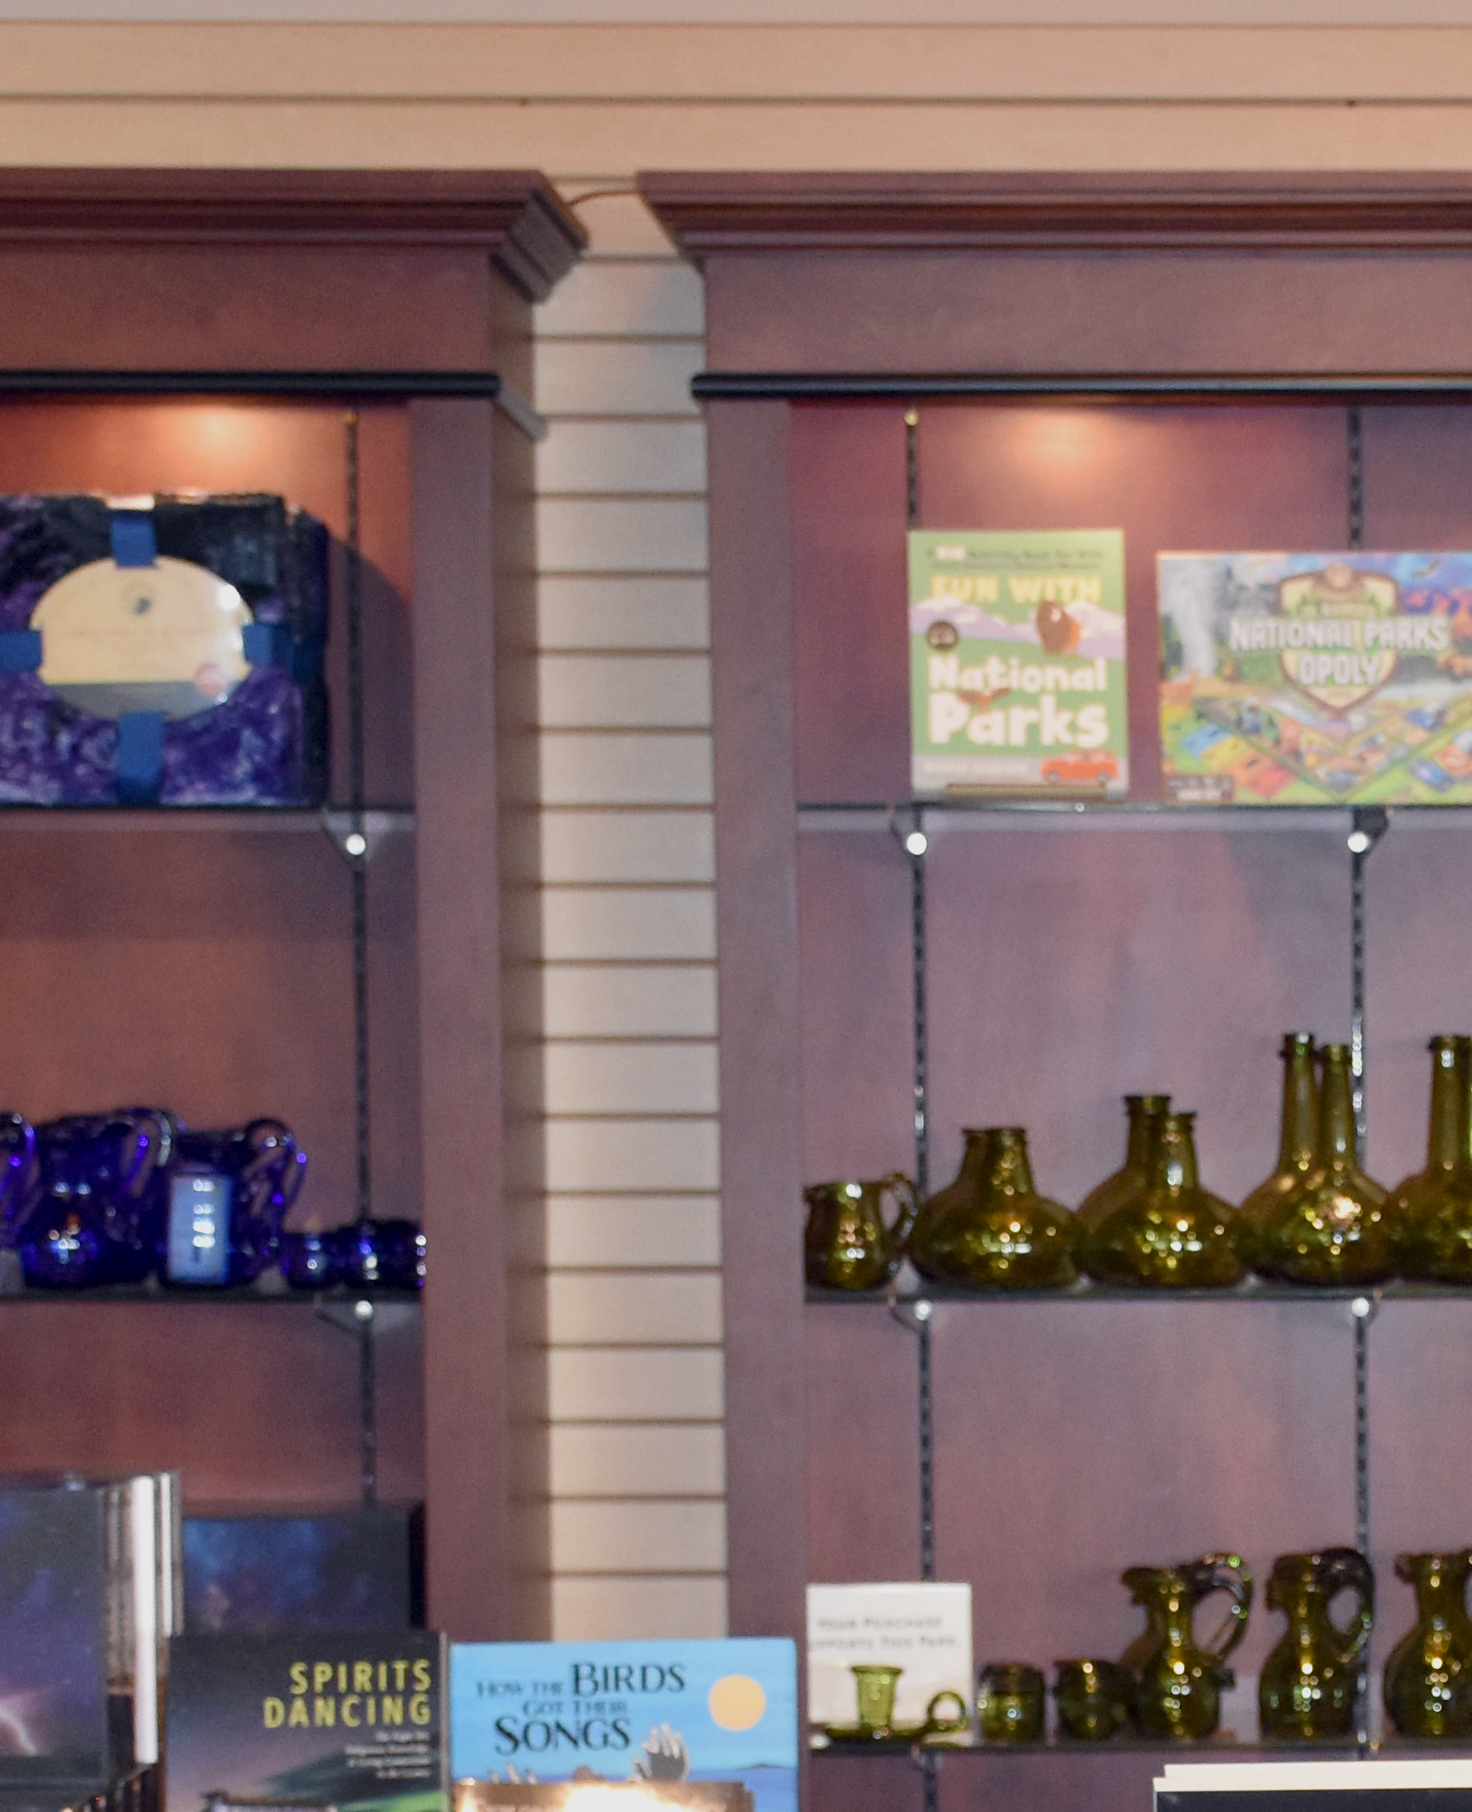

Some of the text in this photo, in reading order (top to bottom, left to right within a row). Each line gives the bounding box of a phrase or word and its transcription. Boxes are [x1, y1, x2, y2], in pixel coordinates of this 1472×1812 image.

[930, 574, 1102, 603] FUN WITH
[1227, 615, 1451, 651] NATIONAL PARKS
[928, 652, 1108, 694] National
[1298, 653, 1380, 685] OPOLY
[928, 691, 1110, 748] Parks
[289, 1658, 432, 1695] SPIRITS
[571, 1661, 687, 1698] BIRDS
[263, 1692, 432, 1729] DANCING
[493, 1714, 633, 1756] SONGS
